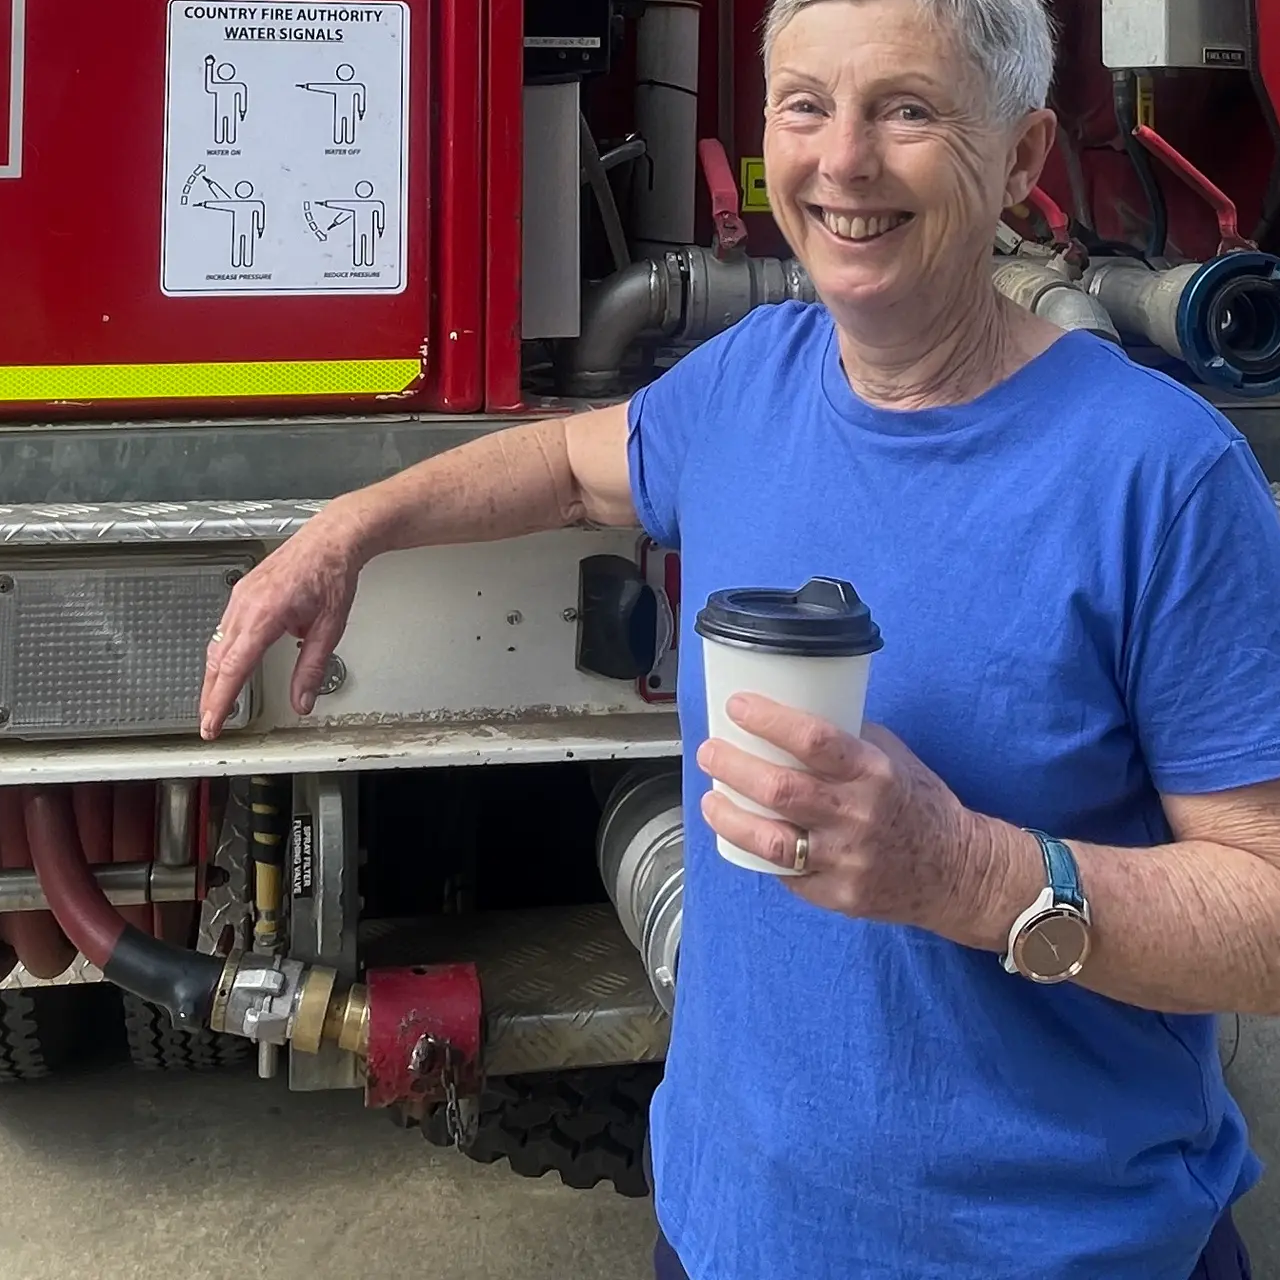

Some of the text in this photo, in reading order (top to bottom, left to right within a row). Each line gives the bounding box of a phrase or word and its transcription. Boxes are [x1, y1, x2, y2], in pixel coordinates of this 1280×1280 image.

[184, 6, 383, 22] COUNTRY FIRE AUTHORITY
[224, 26, 344, 41] WATER SIGNALS
[293, 820, 302, 894] FLUSHING VALVE
[303, 826, 311, 887] SPRAY FILTER
